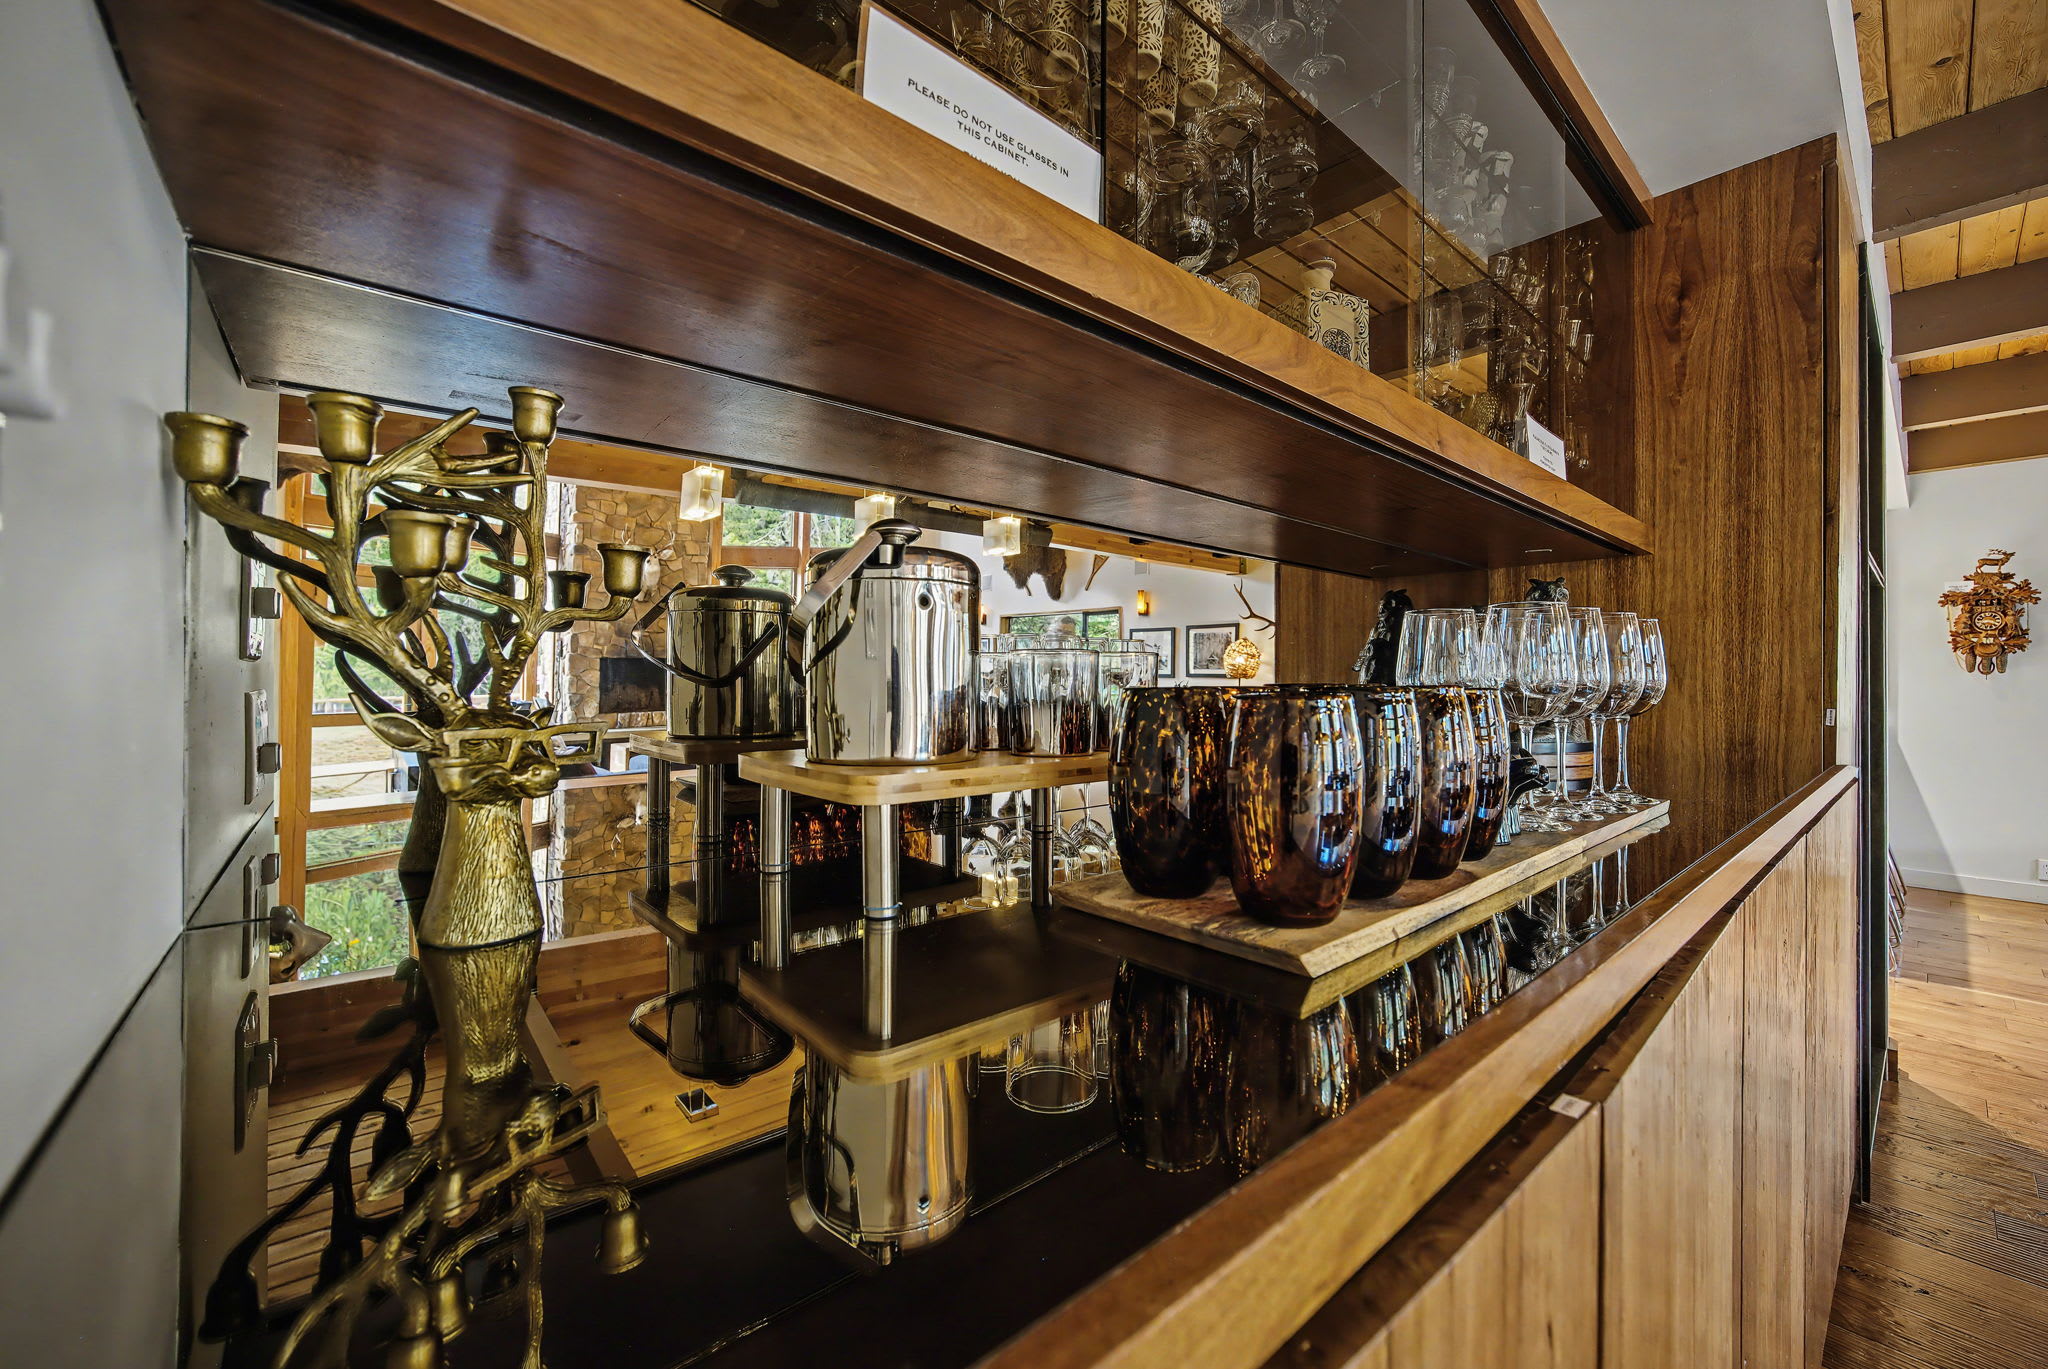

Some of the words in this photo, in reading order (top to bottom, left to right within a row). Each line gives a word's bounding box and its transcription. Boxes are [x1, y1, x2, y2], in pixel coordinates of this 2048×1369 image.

[908, 77, 950, 109] PLEASE
[953, 104, 968, 119] DO
[971, 115, 992, 133] NOT
[995, 129, 1015, 146] USE
[1017, 142, 1058, 171] GLASSES
[1060, 166, 1070, 178] IN
[957, 120, 981, 140] THIS
[984, 136, 1029, 167] CABINET.
